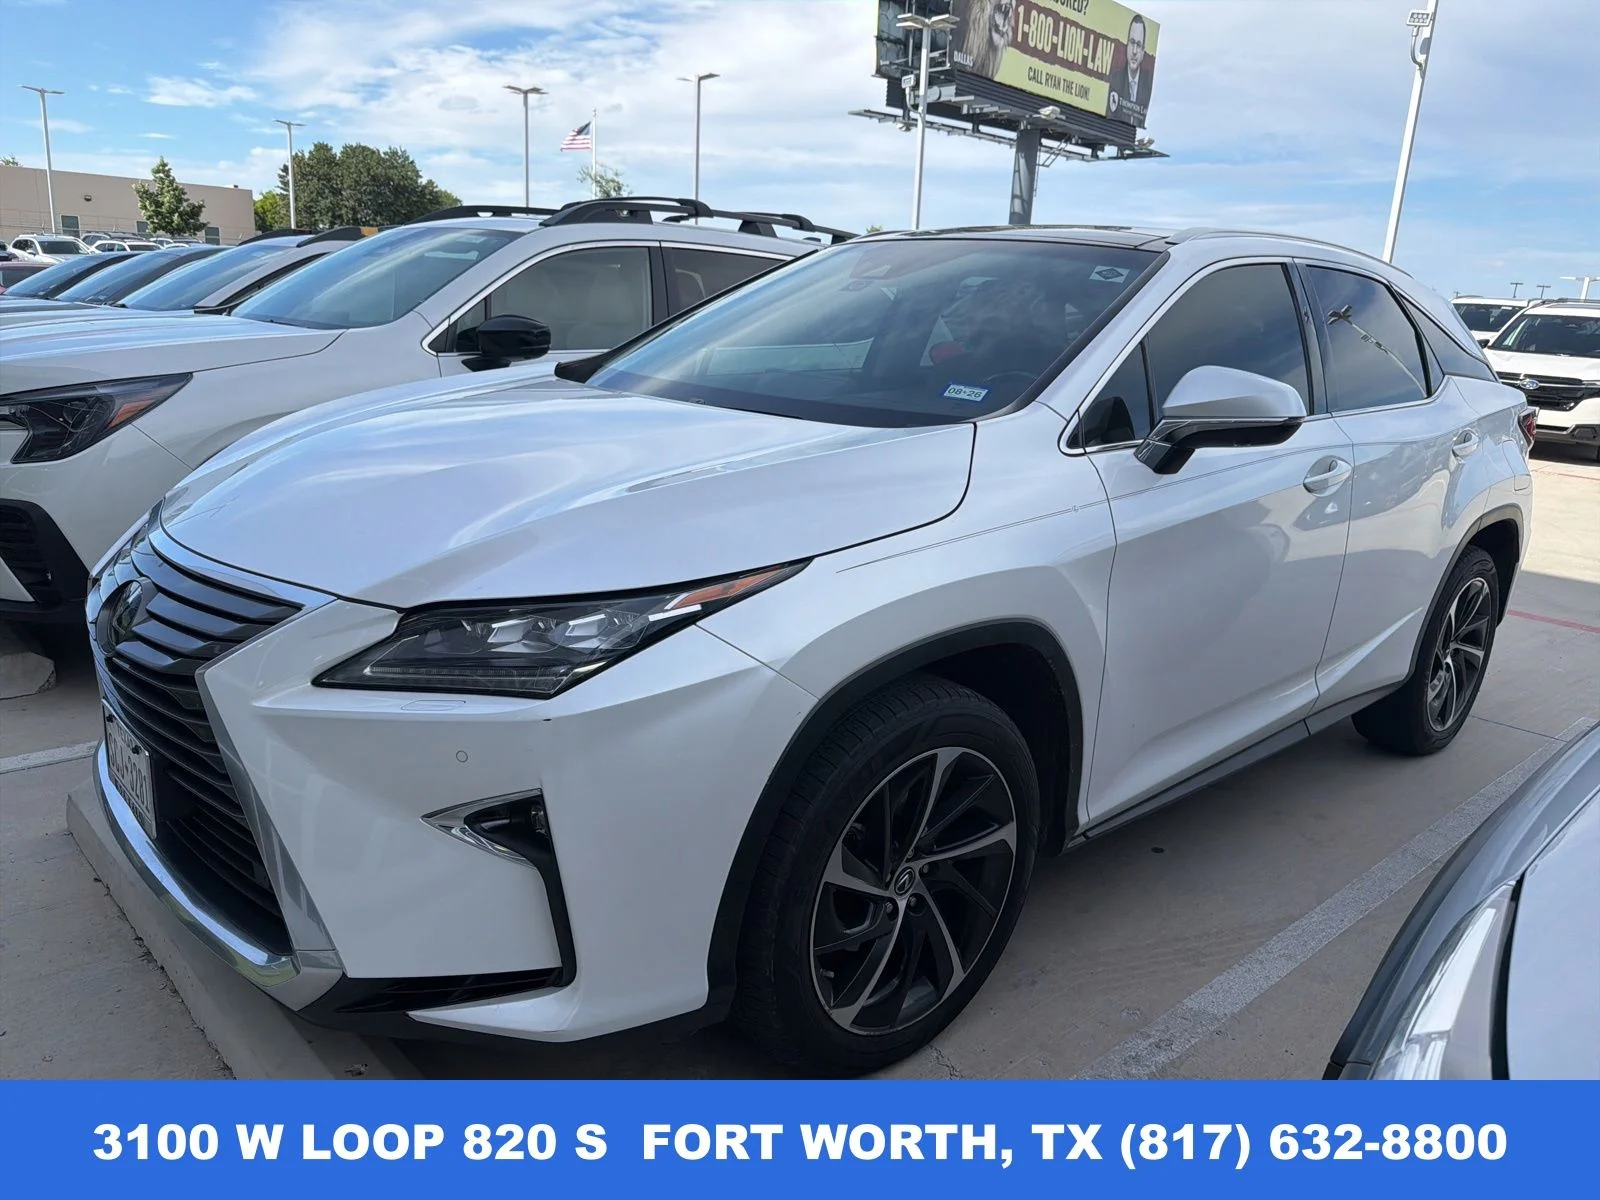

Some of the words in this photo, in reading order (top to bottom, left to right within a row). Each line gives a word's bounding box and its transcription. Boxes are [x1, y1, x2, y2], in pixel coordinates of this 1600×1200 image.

[1017, 5, 1115, 76] 1-800-LION-LAW
[953, 50, 973, 67] DALLAS
[1027, 66, 1043, 85] CALL
[1044, 72, 1061, 91] RYAN
[1062, 78, 1074, 96] THE
